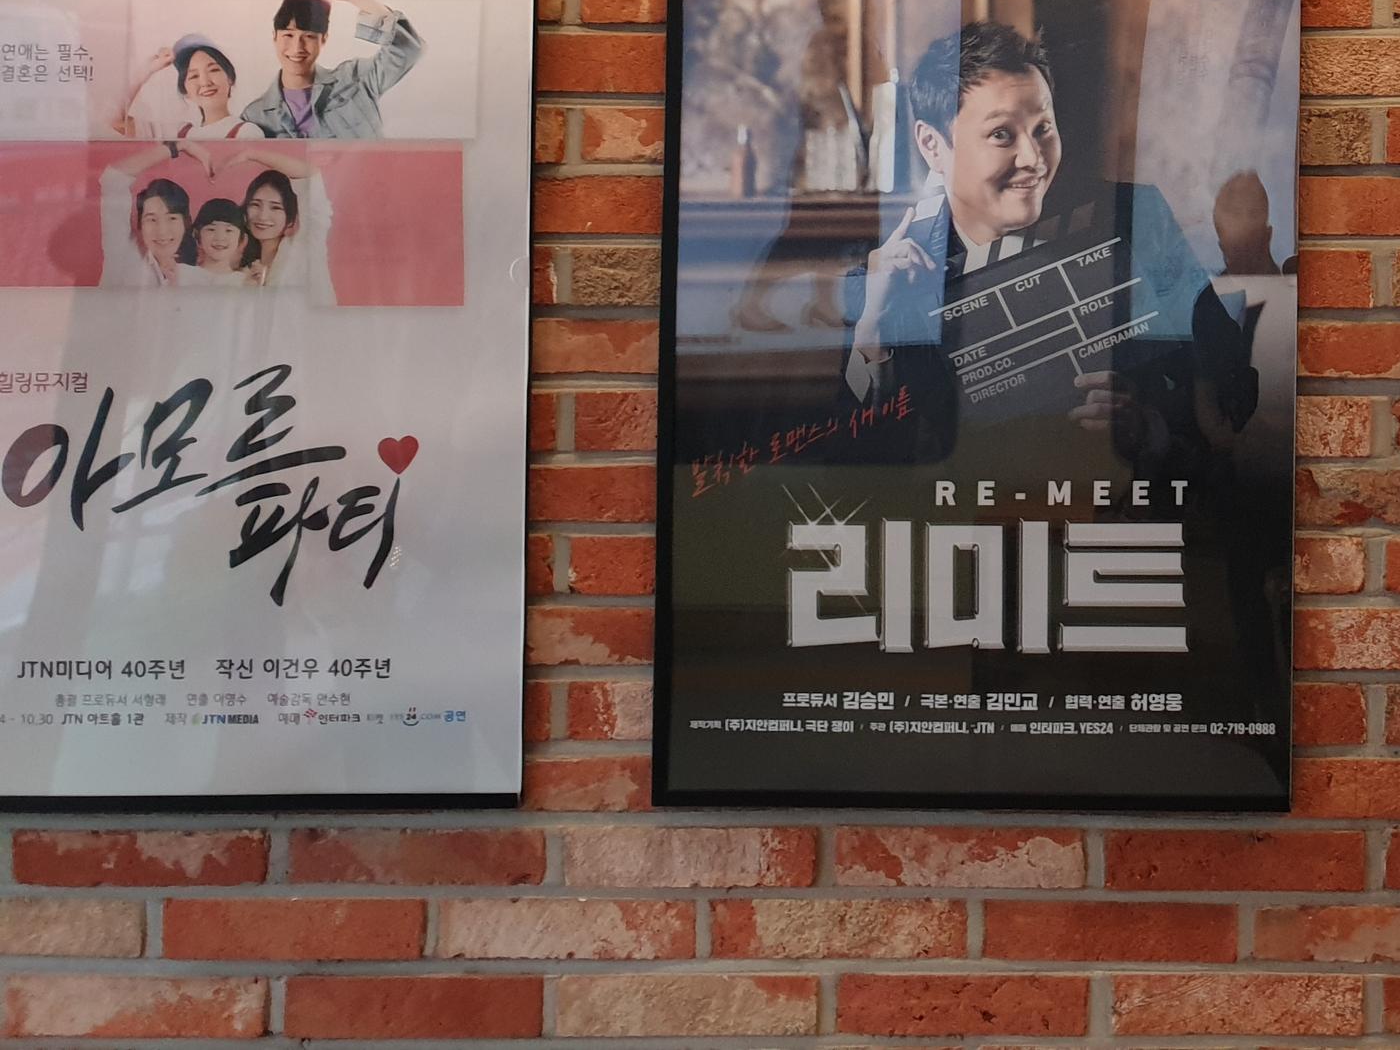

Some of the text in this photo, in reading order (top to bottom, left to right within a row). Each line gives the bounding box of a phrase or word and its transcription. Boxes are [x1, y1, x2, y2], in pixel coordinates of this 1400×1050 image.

[2, 43, 49, 61] 연애는
[1, 64, 94, 82] 결혼은 선택!
[1076, 247, 1112, 267] TAKE
[1014, 274, 1042, 293] CUT
[943, 295, 990, 321] SCENE
[1079, 296, 1114, 315] ROLL
[1078, 322, 1149, 359] CAMERAMAN
[953, 346, 987, 367] DATE
[0, 371, 88, 393] 힐링뮤지컬
[970, 373, 1027, 404] DIRECTOR
[882, 384, 914, 421] 이름
[2, 364, 346, 530] 아모르
[935, 480, 1189, 507] RE-MEET
[230, 476, 399, 606] 파티
[786, 516, 1189, 654] 리미트
[17, 660, 112, 680] JTN미디어
[121, 659, 185, 680] 40주년
[263, 658, 318, 679] 이건우
[328, 658, 391, 679] 40주년
[82, 694, 128, 707] 프로듀서
[782, 692, 837, 708] 프로듀서
[842, 692, 895, 710] 김승민
[986, 693, 1038, 711] 김민교
[1131, 693, 1183, 711] 허영웅
[61, 714, 83, 725] JTN
[127, 713, 144, 726] 1관
[202, 714, 259, 724] JTN MEDIA
[318, 713, 361, 725] 인터파크
[805, 720, 828, 732] 극단
[1080, 722, 1113, 734] YES24
[1210, 722, 1276, 735] 02-719-0988
